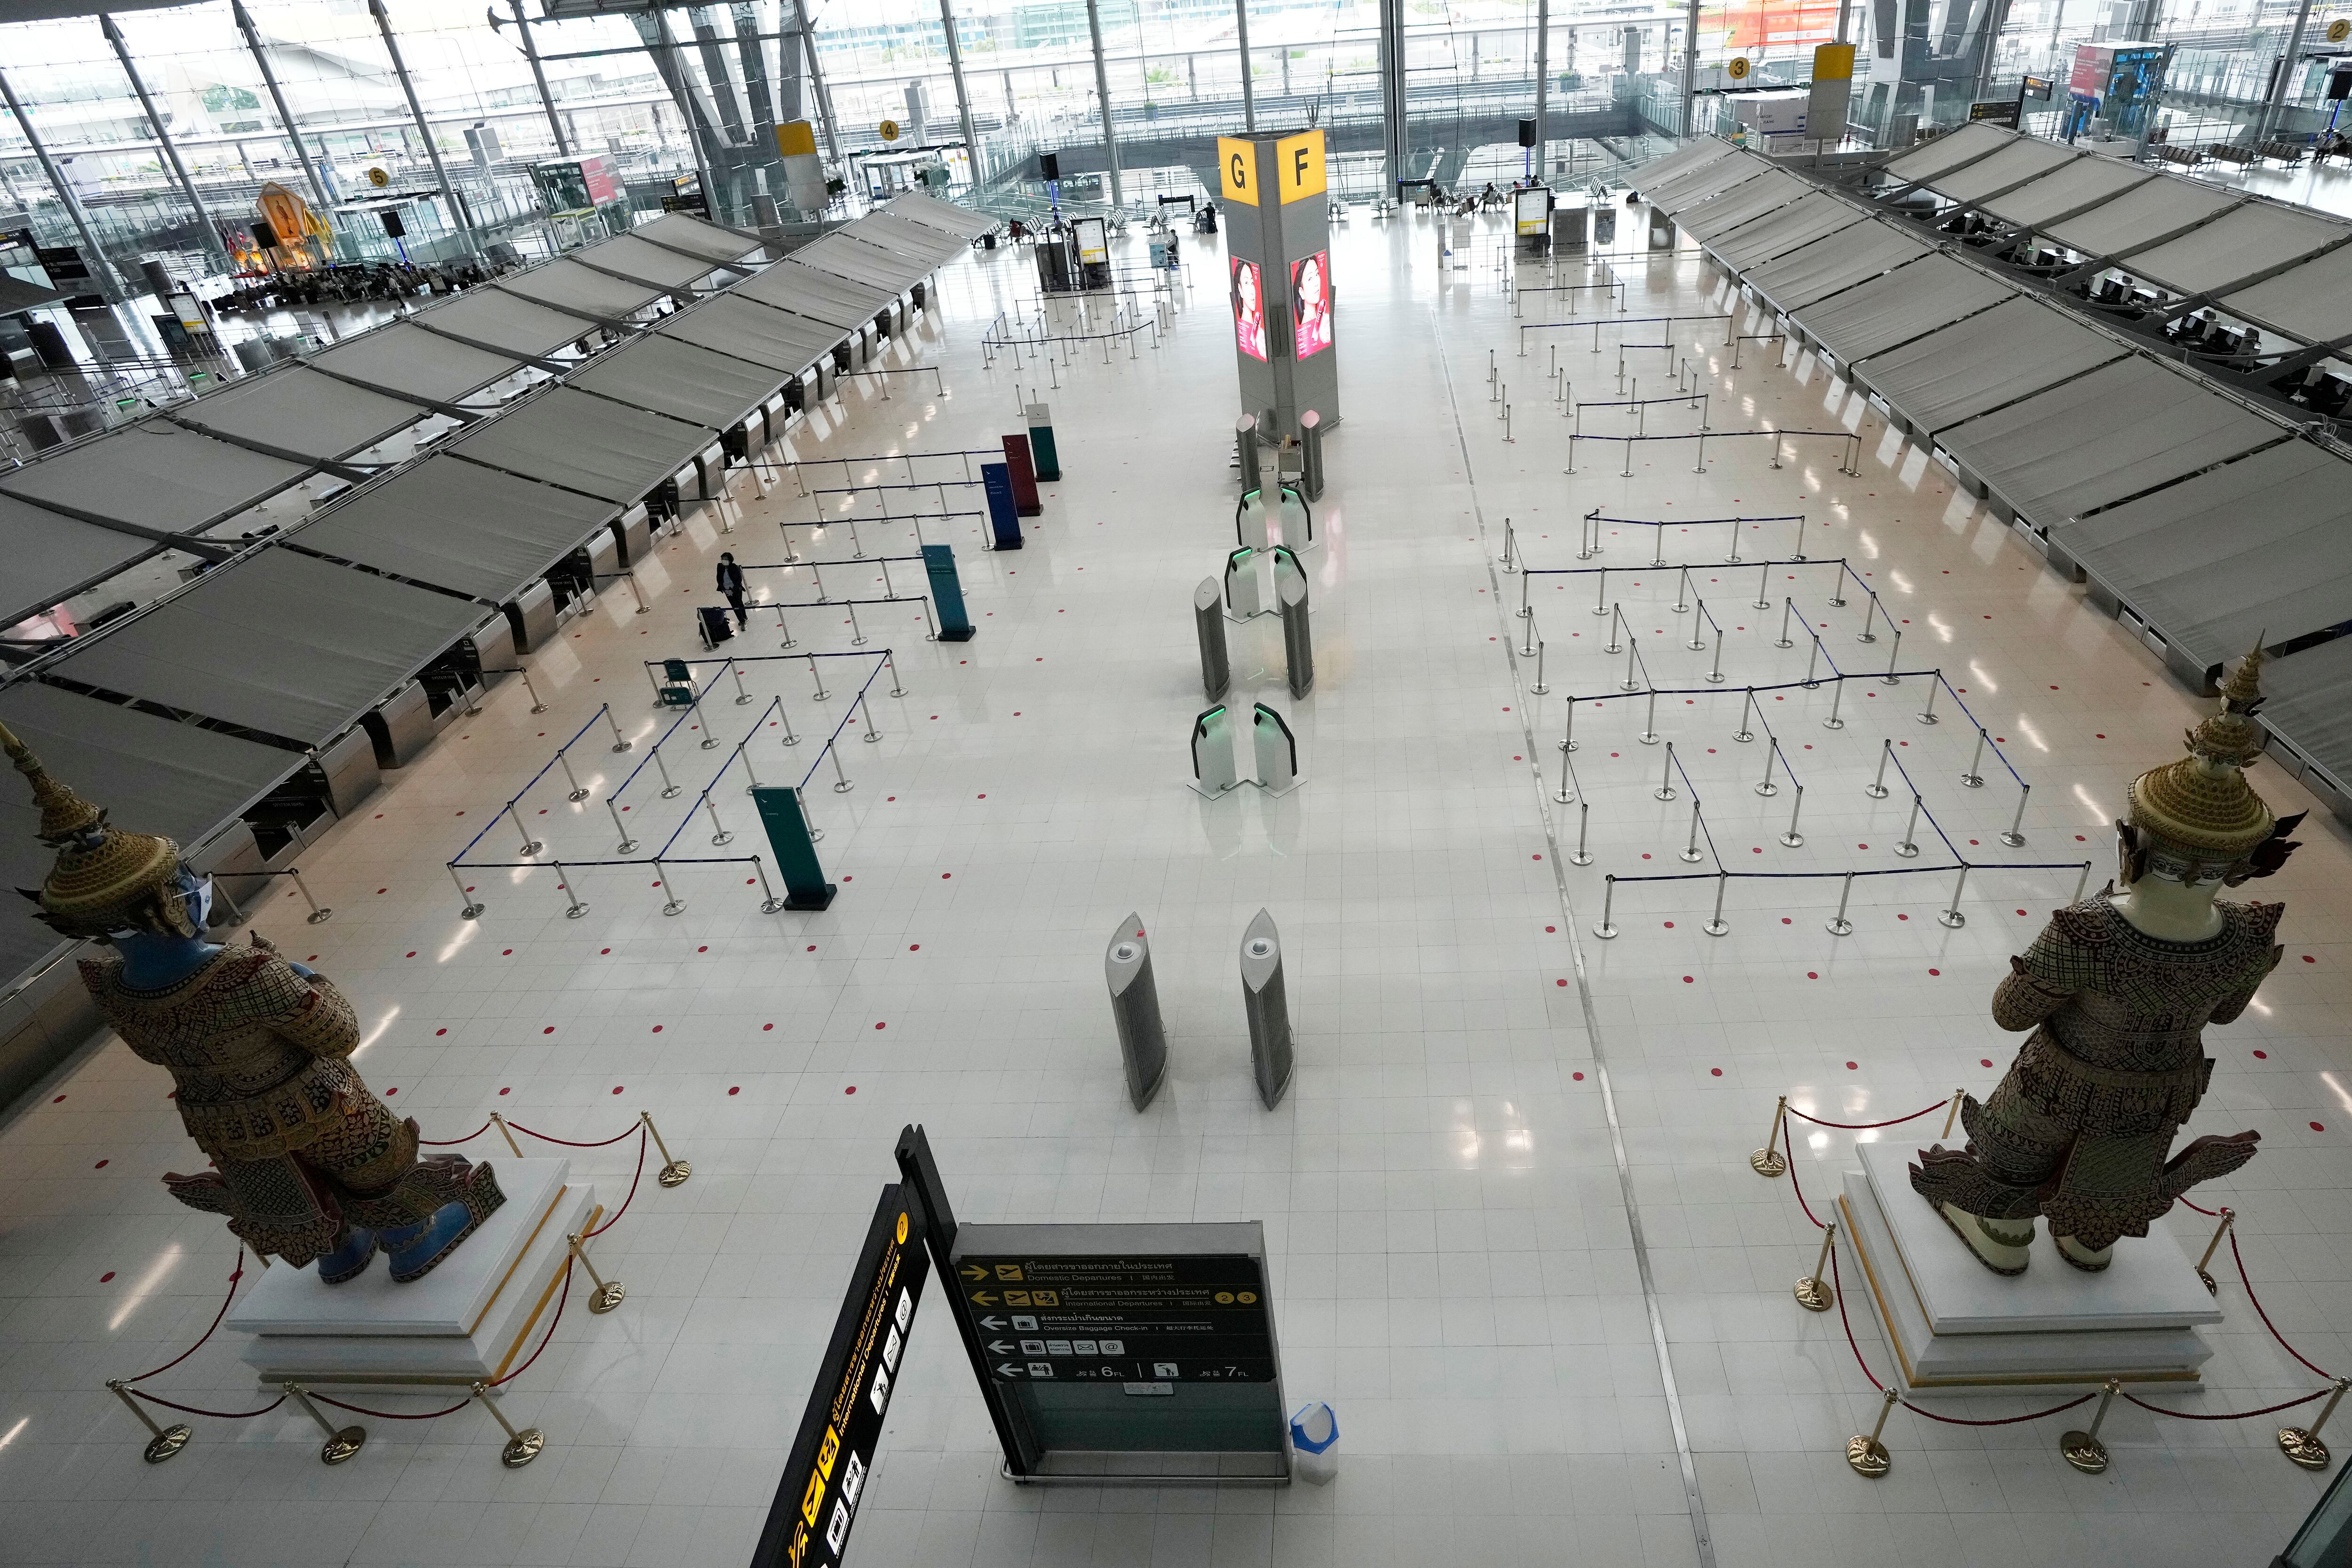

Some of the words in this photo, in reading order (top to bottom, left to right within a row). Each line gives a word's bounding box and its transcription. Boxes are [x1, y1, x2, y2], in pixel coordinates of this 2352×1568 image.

[2332, 24, 2344, 39] 2
[1734, 61, 1744, 75] 3
[885, 123, 894, 137] 4
[1231, 153, 1246, 189] G
[1295, 148, 1308, 186] F
[373, 170, 384, 184] 5
[899, 1221, 905, 1236] 2
[888, 1254, 900, 1288] 国际出发
[1025, 1261, 1173, 1272] ผู้โดยสารขาออกภายในประเทศ
[1061, 1287, 1209, 1298] ผู้โดยสารขาออกระหว่างประเทศ
[1041, 1312, 1123, 1321] ส่งกระเป๋าเกินขนาด
[832, 1237, 895, 1422] ผู้โดยสารขาออกระหว่างประเทศ
[839, 1360, 866, 1437] International
[865, 1298, 886, 1360] Departures
